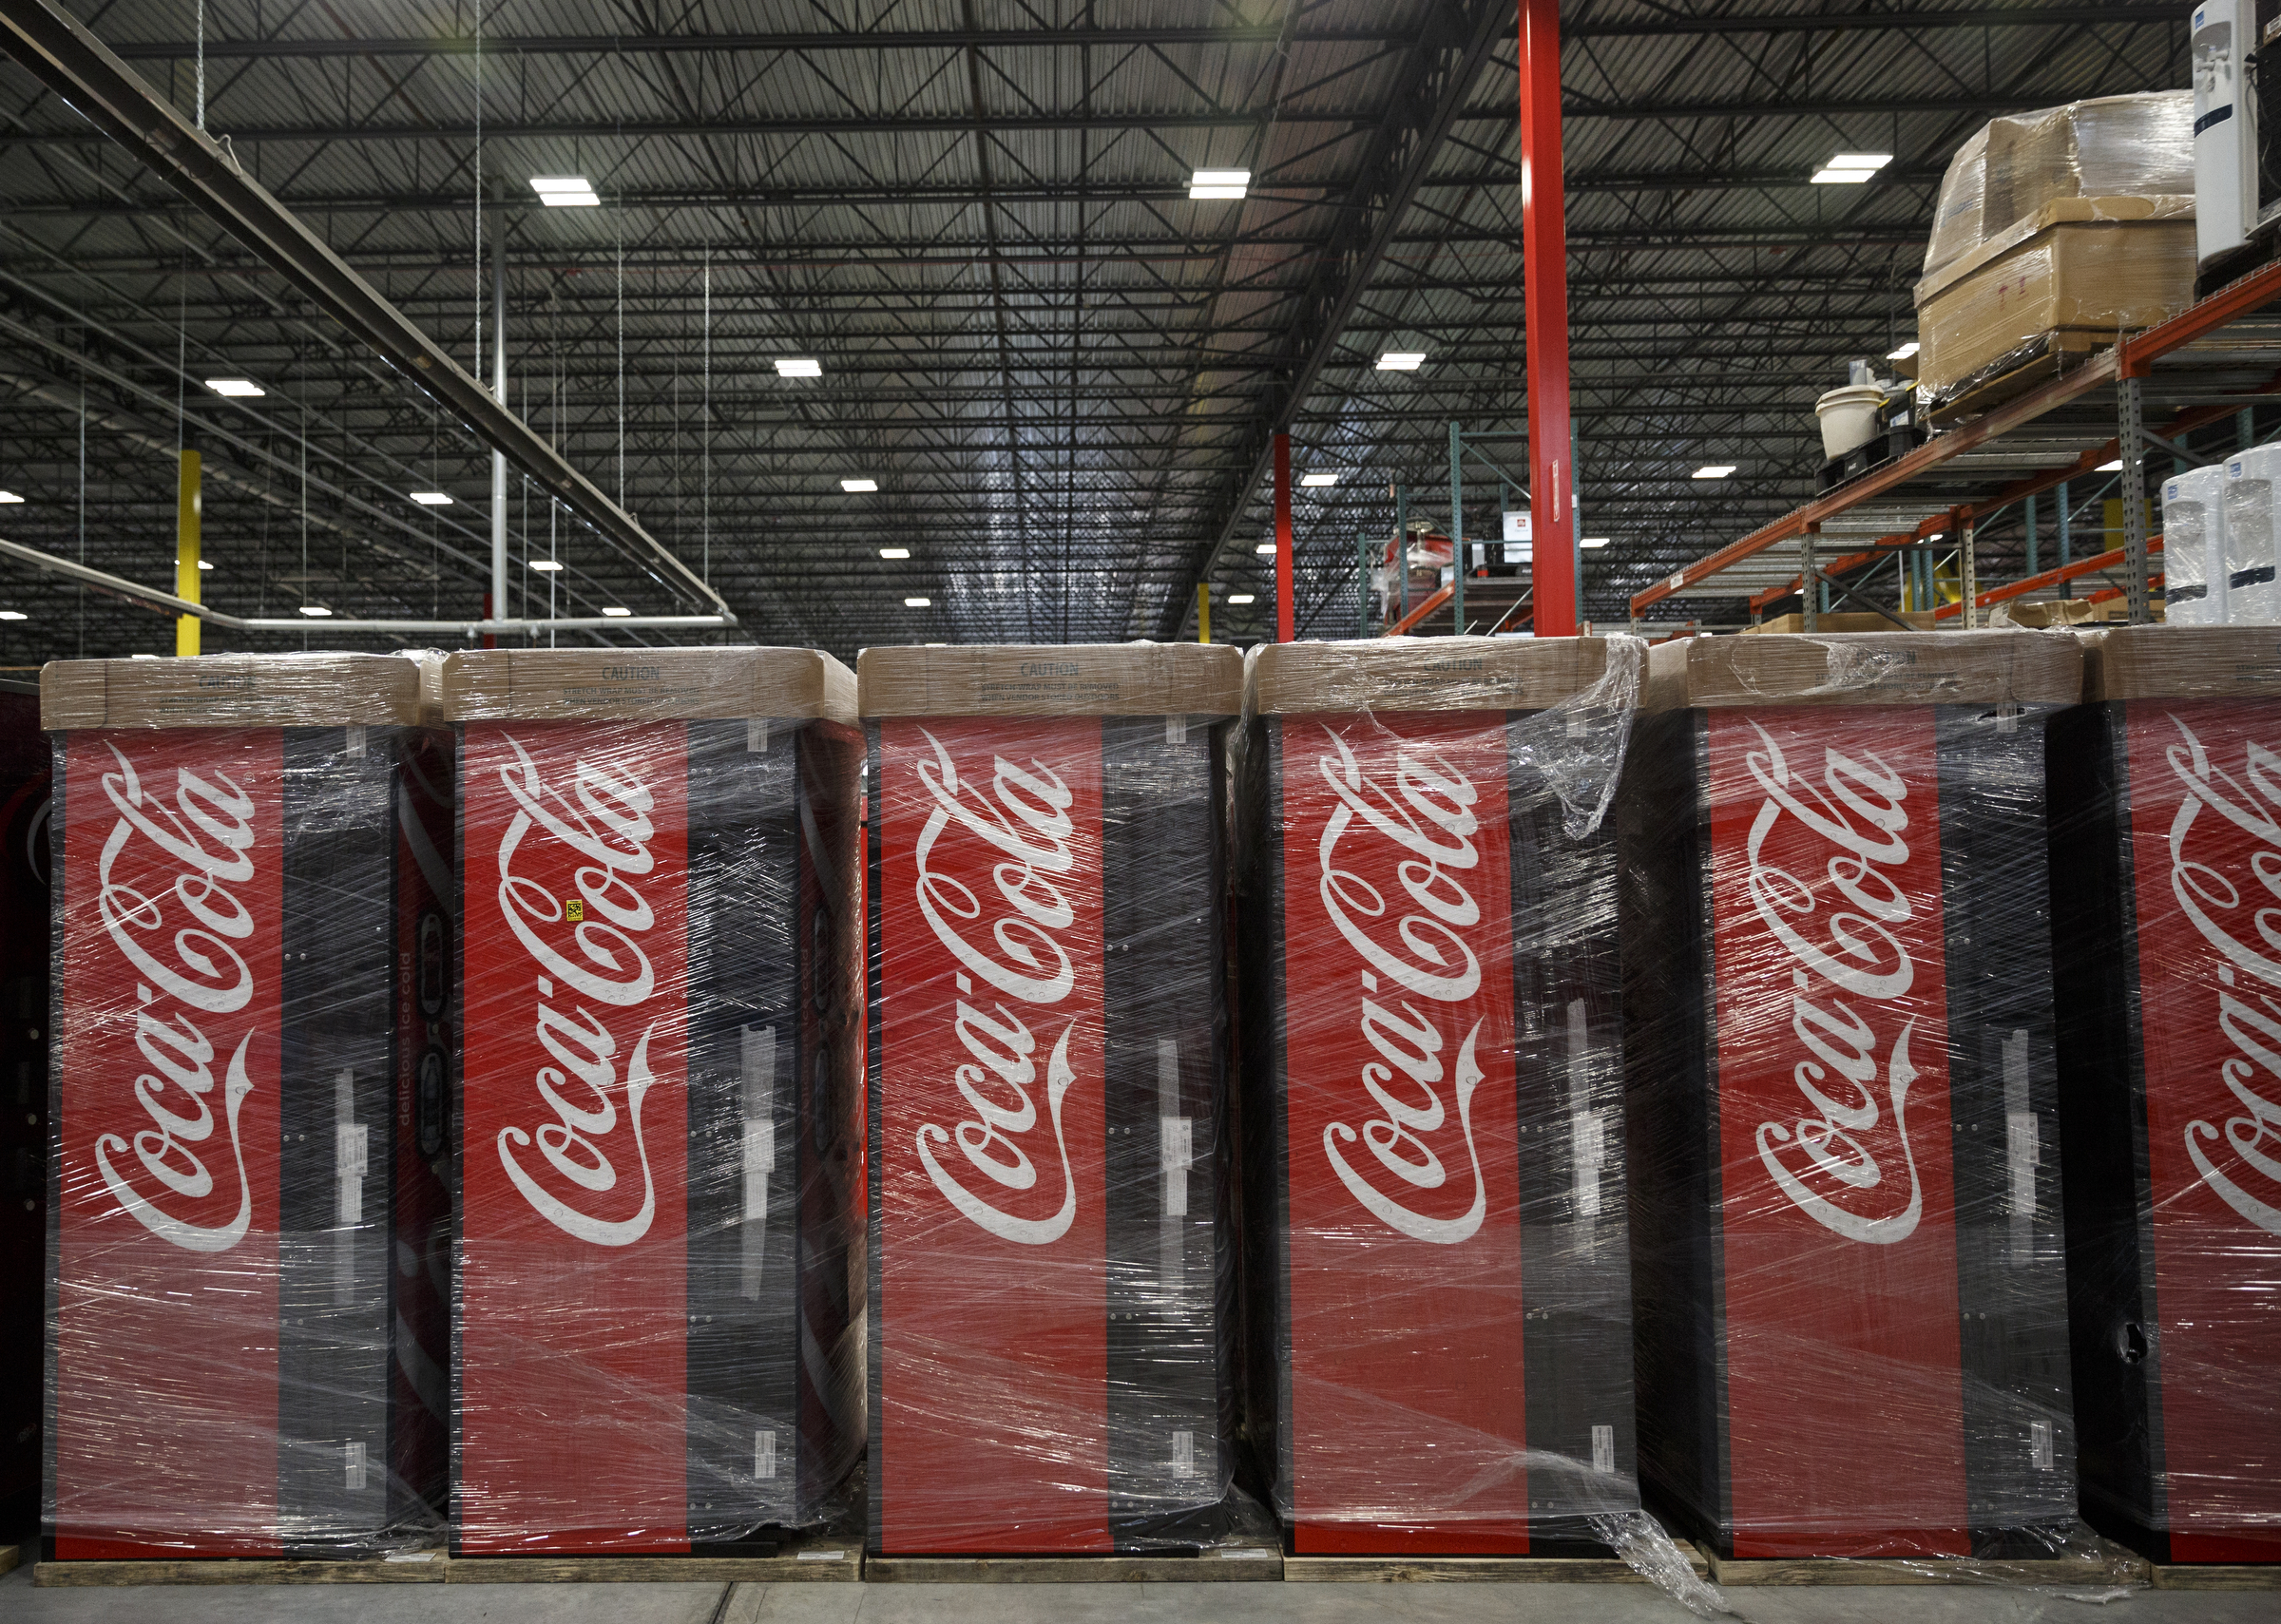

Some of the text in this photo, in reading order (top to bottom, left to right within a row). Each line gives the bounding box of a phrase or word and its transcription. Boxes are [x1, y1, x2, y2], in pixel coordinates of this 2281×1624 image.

[603, 666, 660, 680] CAUTION
[1020, 662, 1079, 677] CAUTION
[1080, 682, 1120, 691] REMOVED
[1424, 658, 1483, 671] CAUTION
[95, 738, 255, 1252] Coca-Cola
[398, 952, 411, 1127] delicious ice cold
[496, 730, 657, 1247] Coca-Cola
[915, 724, 1077, 1246] Coca-Cola
[1318, 720, 1486, 1245] Coca-Cola
[1745, 716, 1923, 1245] Coca-Cola
